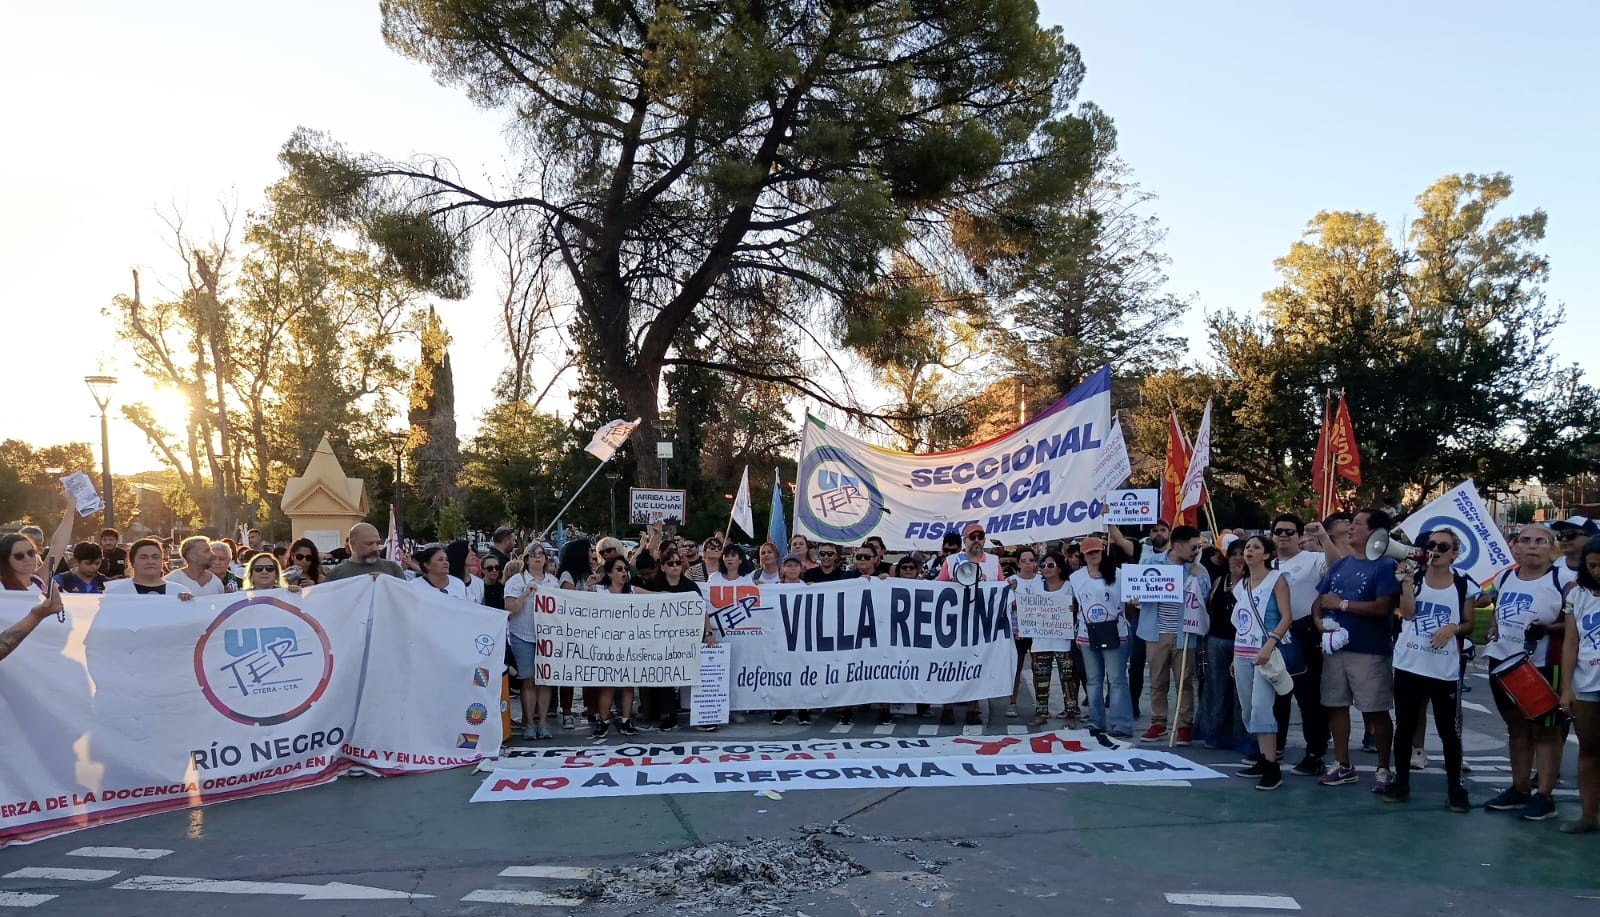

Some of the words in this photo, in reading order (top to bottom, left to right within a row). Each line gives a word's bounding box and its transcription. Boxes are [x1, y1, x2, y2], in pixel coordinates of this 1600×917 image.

[911, 422, 1101, 488] SECCIONAL
[633, 502, 649, 510] QUE
[812, 486, 868, 518] TER
[961, 470, 1050, 511] ROCA
[1453, 498, 1476, 523] FISKE
[1489, 541, 1510, 566] ROCA
[534, 594, 556, 614] NO
[557, 600, 566, 615] al
[569, 603, 640, 619] vaciamiento
[642, 603, 656, 618] de
[660, 600, 703, 618] ANSES
[708, 597, 774, 638] TER
[779, 589, 878, 651] VILLA
[891, 585, 1012, 649] REGINA
[536, 623, 563, 638] para
[628, 631, 635, 640] a
[636, 626, 651, 640] las
[654, 624, 700, 642] Empresas
[536, 640, 553, 658] NO
[553, 642, 563, 658] al
[616, 649, 625, 661] de
[665, 643, 697, 661] Laboral)
[220, 639, 312, 696] TER
[536, 663, 551, 680] NO
[553, 671, 560, 680] a
[562, 664, 572, 680] la
[574, 665, 630, 682] REFORMA
[633, 666, 691, 683] LABORAL
[738, 665, 792, 691] defensa
[800, 666, 818, 686] de
[825, 664, 839, 685] la
[847, 659, 919, 684] Educación
[926, 660, 983, 682] Pública
[253, 686, 278, 695] CTERA
[284, 684, 298, 692] CTA
[191, 741, 242, 771] RÍO
[251, 727, 345, 763] NEGRO
[0, 801, 41, 818] ERZA
[46, 795, 68, 811] DE
[73, 792, 96, 806] LA
[102, 782, 197, 800] DOCENCIA
[203, 758, 301, 790] ORGANIZADA
[305, 756, 326, 770] EN
[383, 751, 394, 761] Y
[397, 752, 410, 763] EN
[413, 753, 436, 765] LAS
[490, 776, 570, 792] NO
[580, 773, 619, 788] A
[635, 771, 700, 787] LA
[714, 761, 955, 784] REFORMA
[962, 757, 1195, 777] LABORAL
